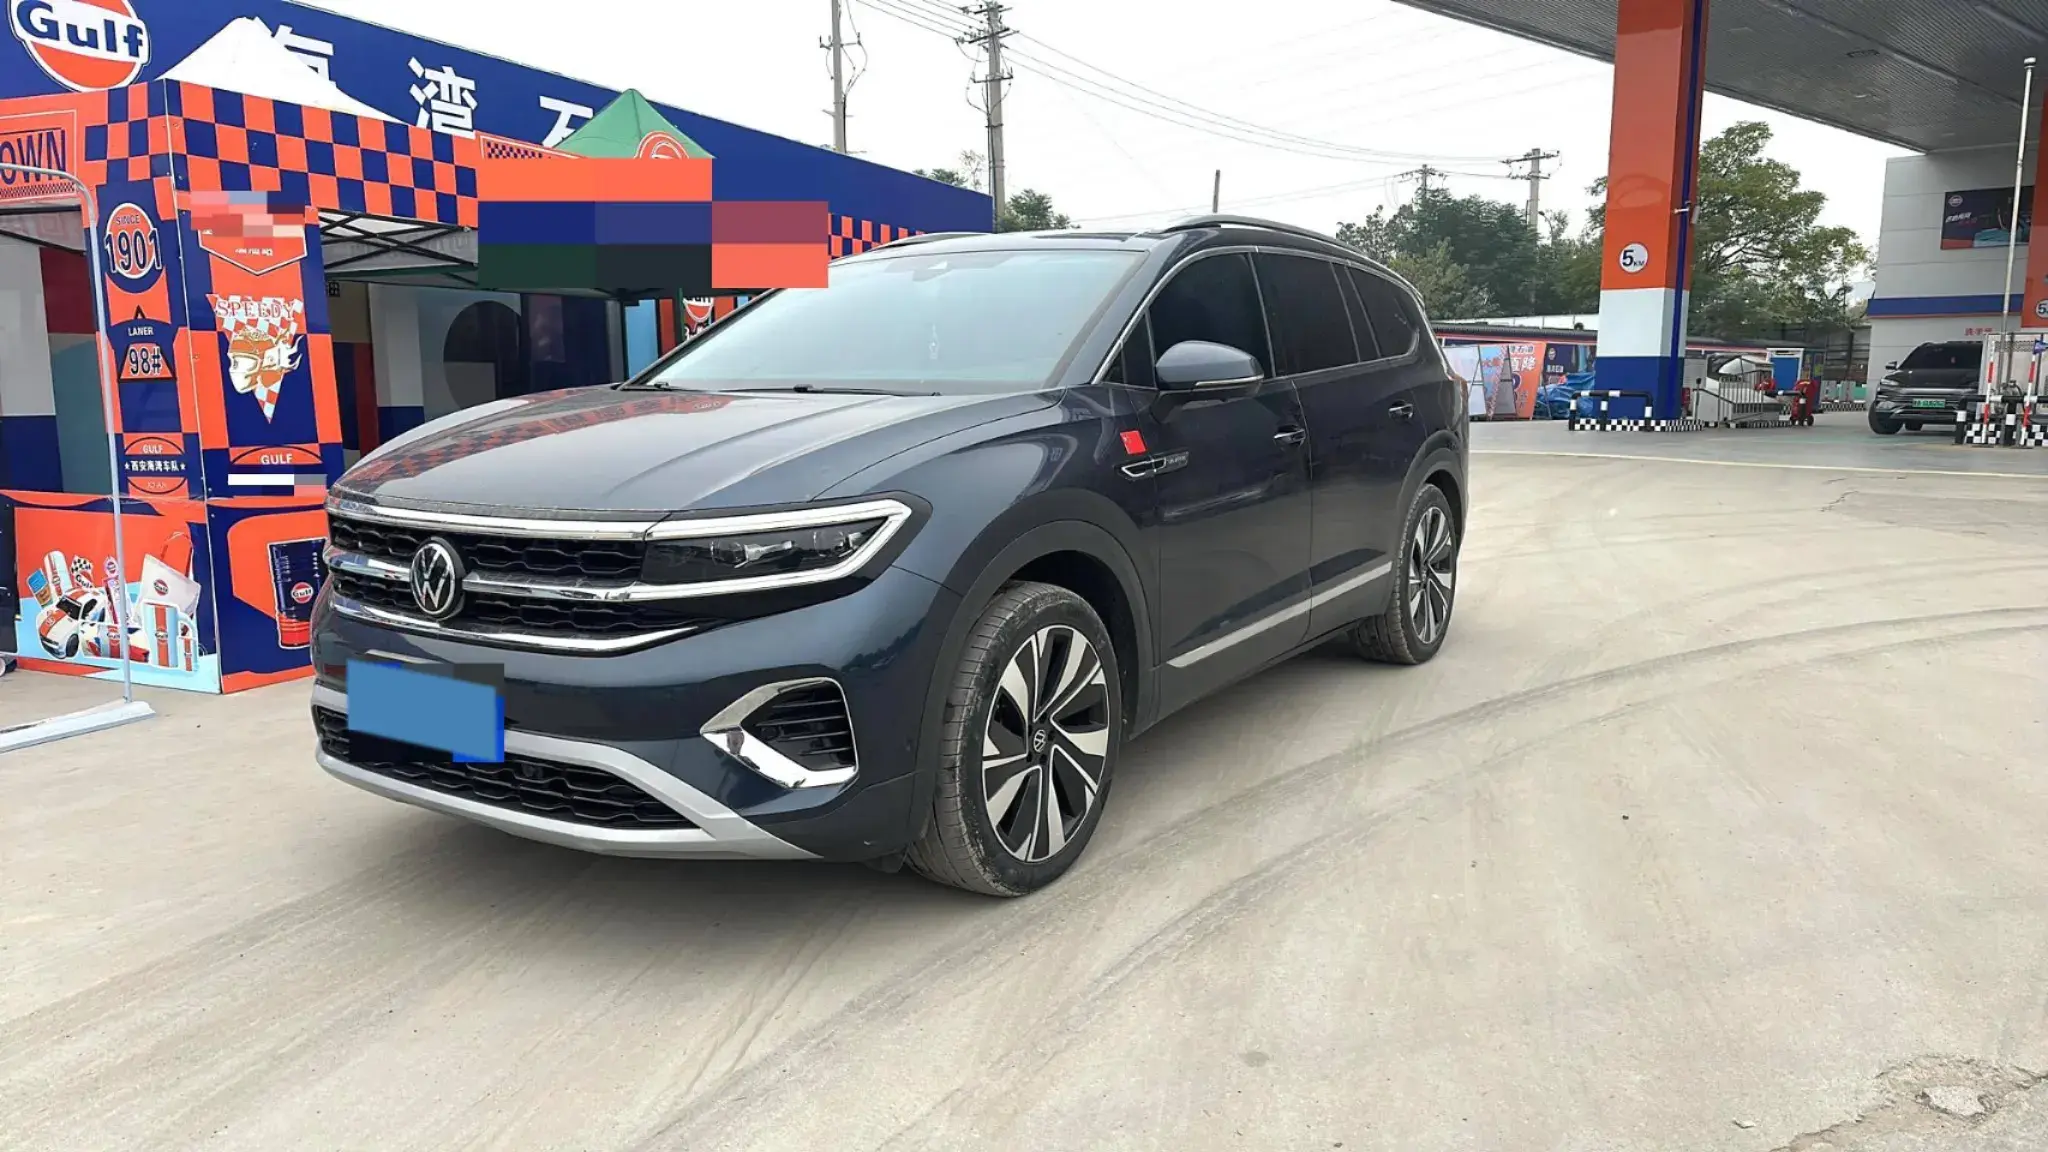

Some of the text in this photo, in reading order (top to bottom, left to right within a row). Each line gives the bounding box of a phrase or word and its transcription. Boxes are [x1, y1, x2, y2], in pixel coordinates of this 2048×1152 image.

[16, 0, 144, 59] Gulf
[115, 214, 140, 226] SINCE
[104, 228, 162, 273] 1901
[216, 299, 296, 320] SPEEDY
[127, 326, 155, 337] LANER
[128, 346, 162, 375] 98#
[142, 444, 163, 454] GULF
[260, 453, 294, 466] GULF
[292, 589, 313, 599] Gulf
